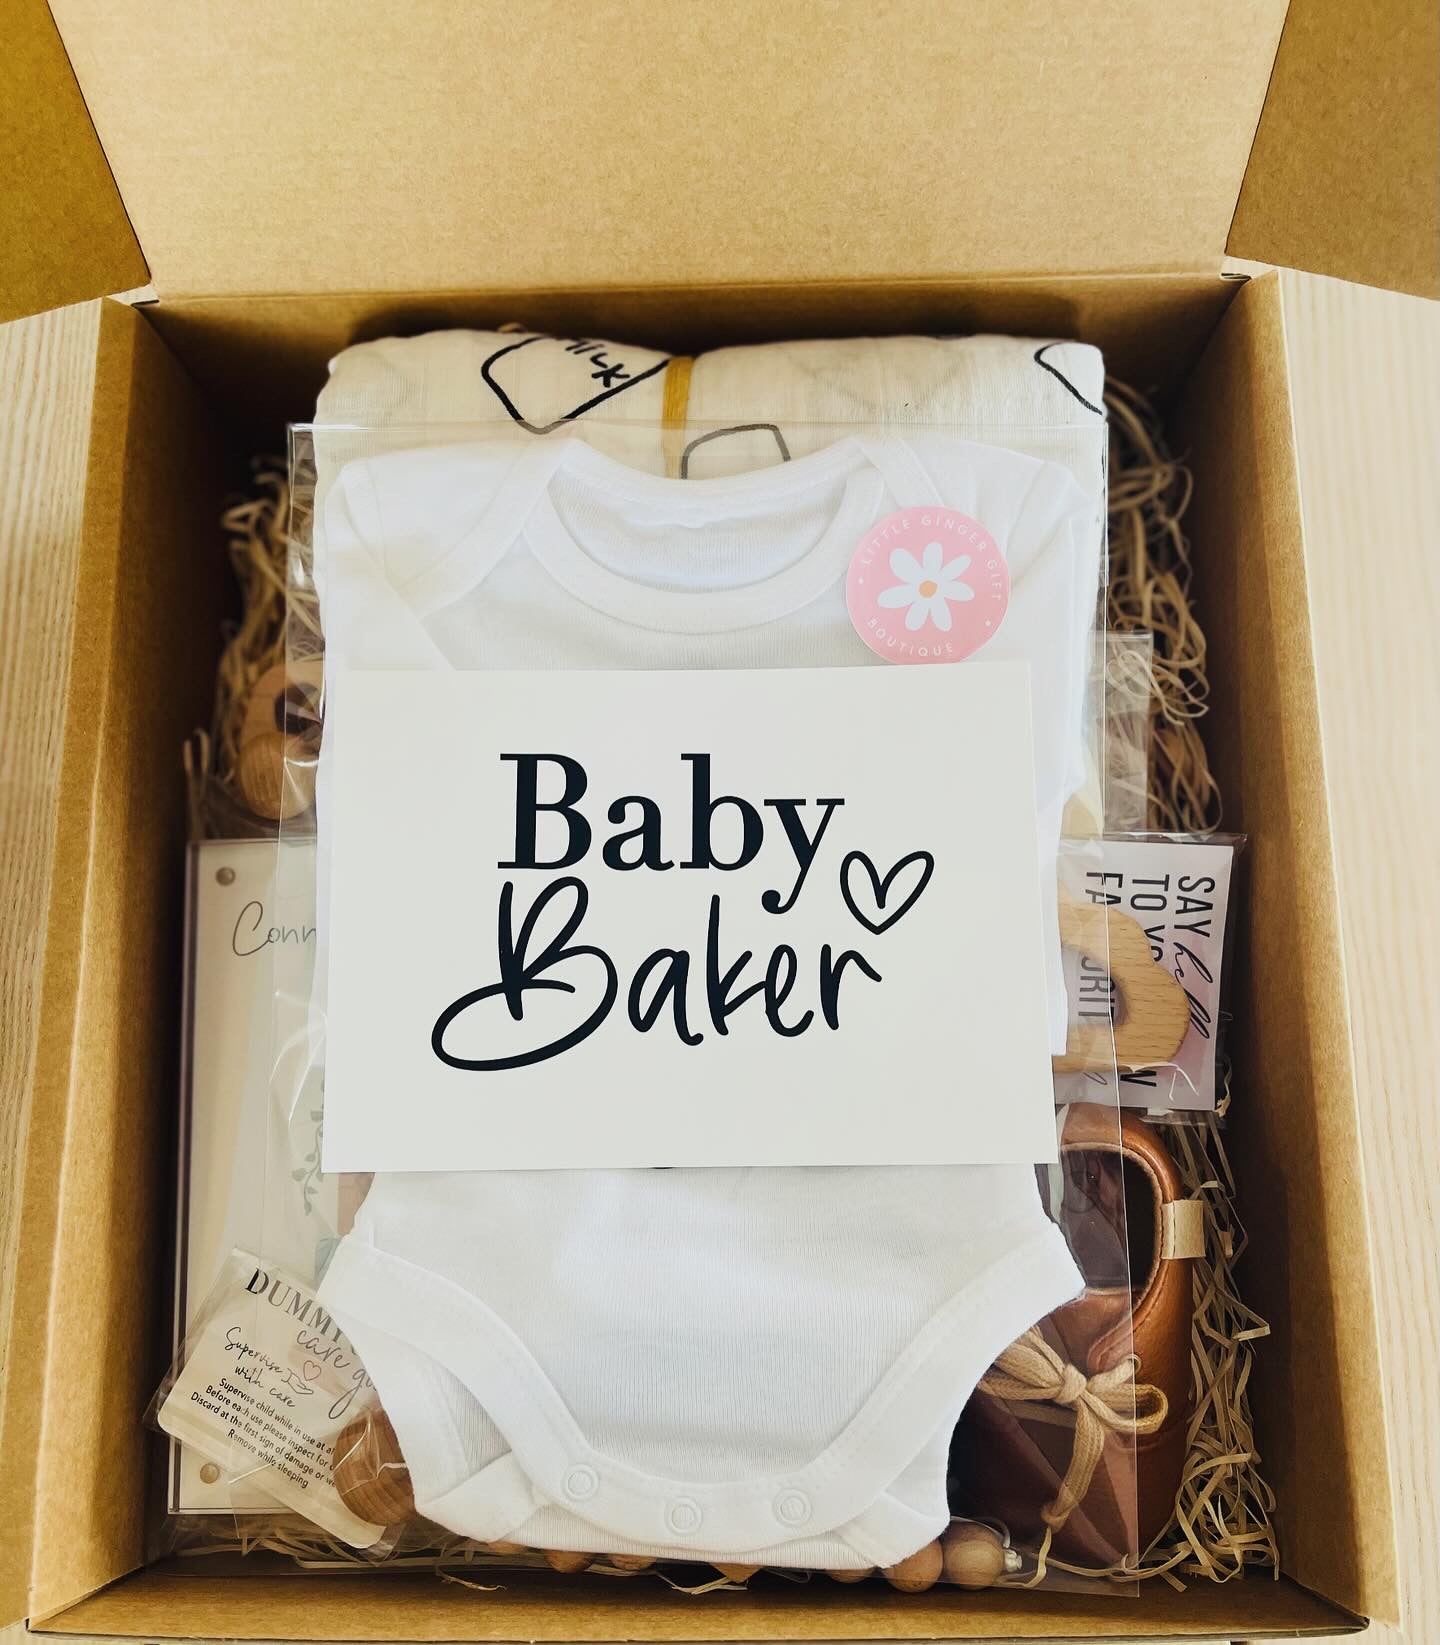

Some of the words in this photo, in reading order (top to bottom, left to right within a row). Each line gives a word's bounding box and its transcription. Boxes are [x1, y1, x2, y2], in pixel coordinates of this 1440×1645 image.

[565, 341, 630, 388] ILK
[861, 518, 911, 567] LITTLE
[921, 514, 987, 552] GINGER
[985, 558, 1001, 600] GIFT
[867, 617, 953, 657] BOUTIQUE
[497, 753, 845, 914] Baby
[1130, 874, 1170, 911] TO
[1173, 875, 1216, 938] SAY
[431, 876, 882, 1072] Baker
[224, 1326, 283, 1373] Supervise
[296, 1329, 351, 1369] care
[219, 1378, 255, 1405] Supervise
[255, 1402, 275, 1418] child
[274, 1415, 294, 1431] while
[293, 1425, 302, 1437] in
[302, 1433, 316, 1446] use
[316, 1440, 325, 1451] at
[234, 1365, 264, 1389] with
[268, 1387, 296, 1408] care
[190, 1392, 221, 1414] Discard
[220, 1411, 230, 1421] at
[229, 1413, 242, 1428] the
[243, 1422, 259, 1438] first
[259, 1435, 274, 1451] sign
[275, 1445, 285, 1455] of
[284, 1451, 314, 1476] damage
[315, 1471, 325, 1480] or
[205, 1385, 231, 1406] Before
[250, 1414, 263, 1426] use
[263, 1422, 287, 1442] please
[287, 1438, 315, 1459] inspect
[316, 1453, 329, 1467] for
[228, 1428, 256, 1454] Remove
[258, 1449, 277, 1467] while
[277, 1461, 310, 1489] sleeping
